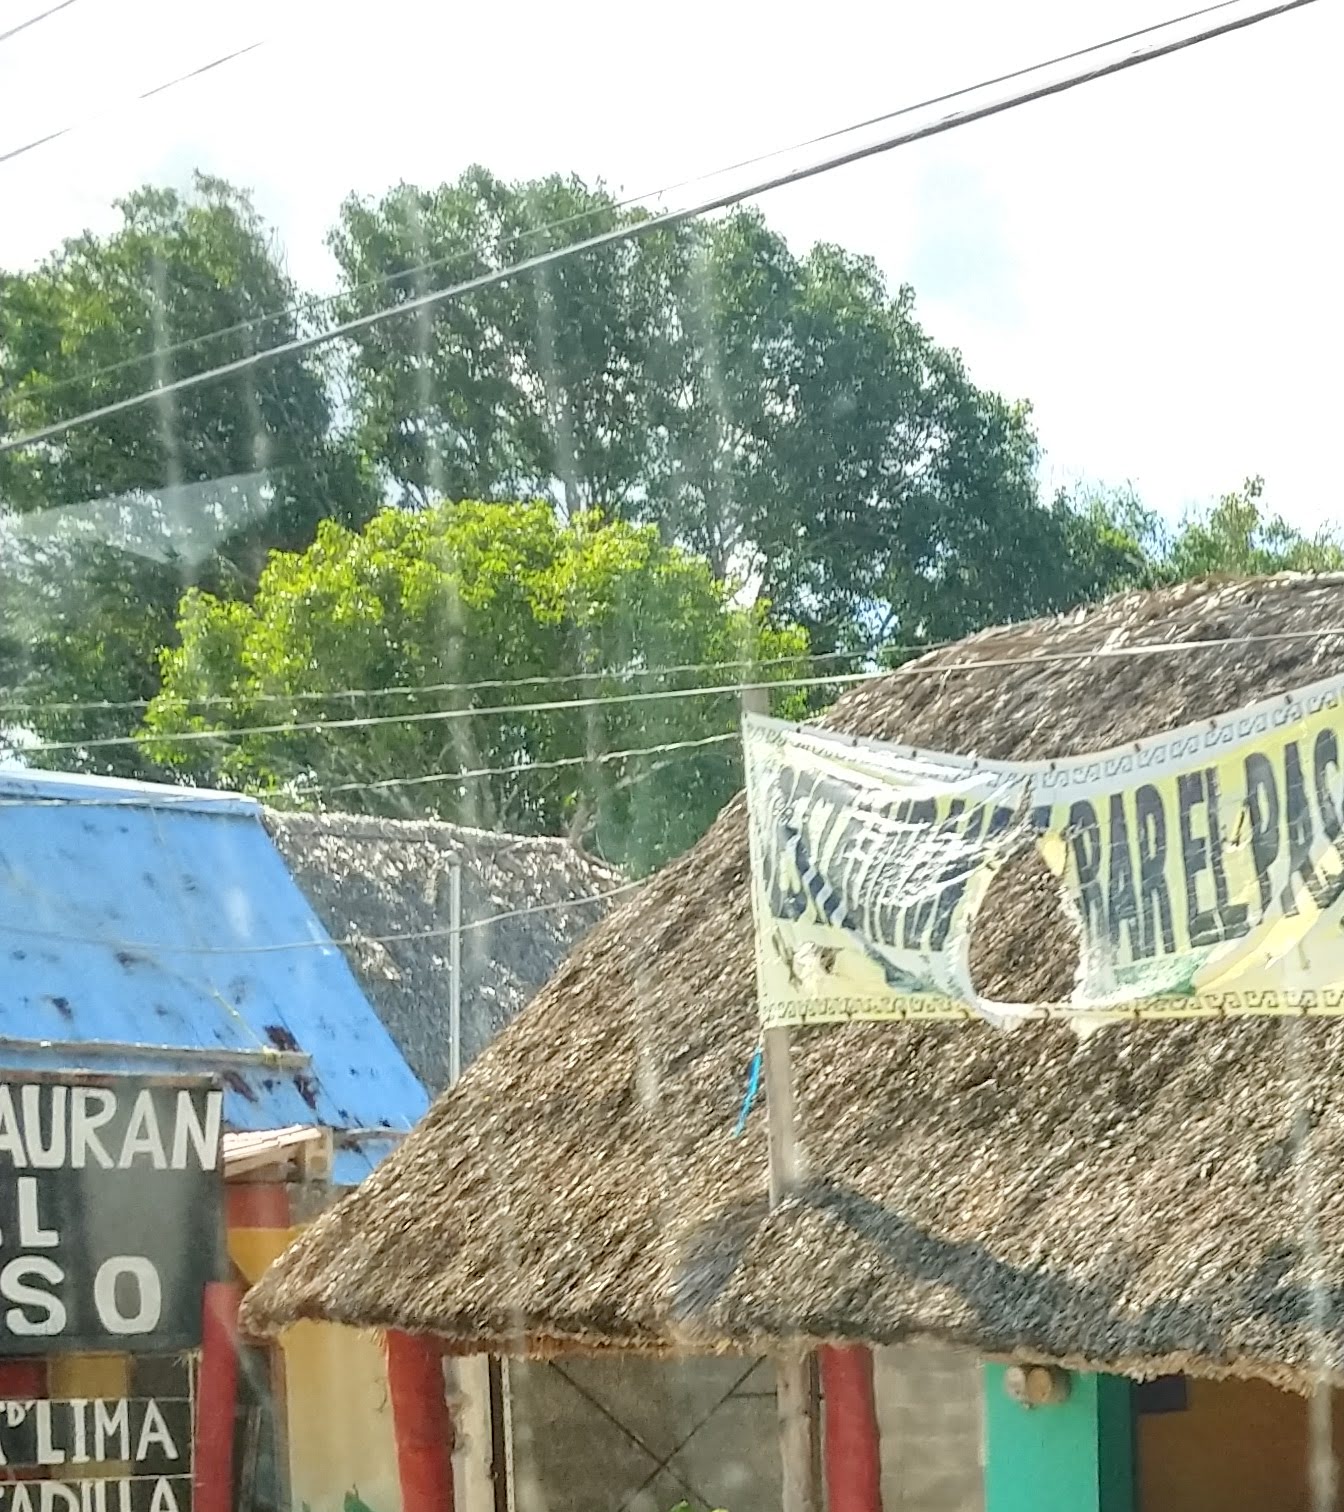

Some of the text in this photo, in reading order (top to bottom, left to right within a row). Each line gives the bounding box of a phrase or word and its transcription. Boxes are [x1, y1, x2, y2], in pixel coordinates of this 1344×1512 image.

[1176, 766, 1252, 949] EL
[0, 1084, 223, 1170] AURAN
[0, 1176, 60, 1248] L
[0, 1255, 162, 1336] SO
[37, 1398, 179, 1464] LIMA
